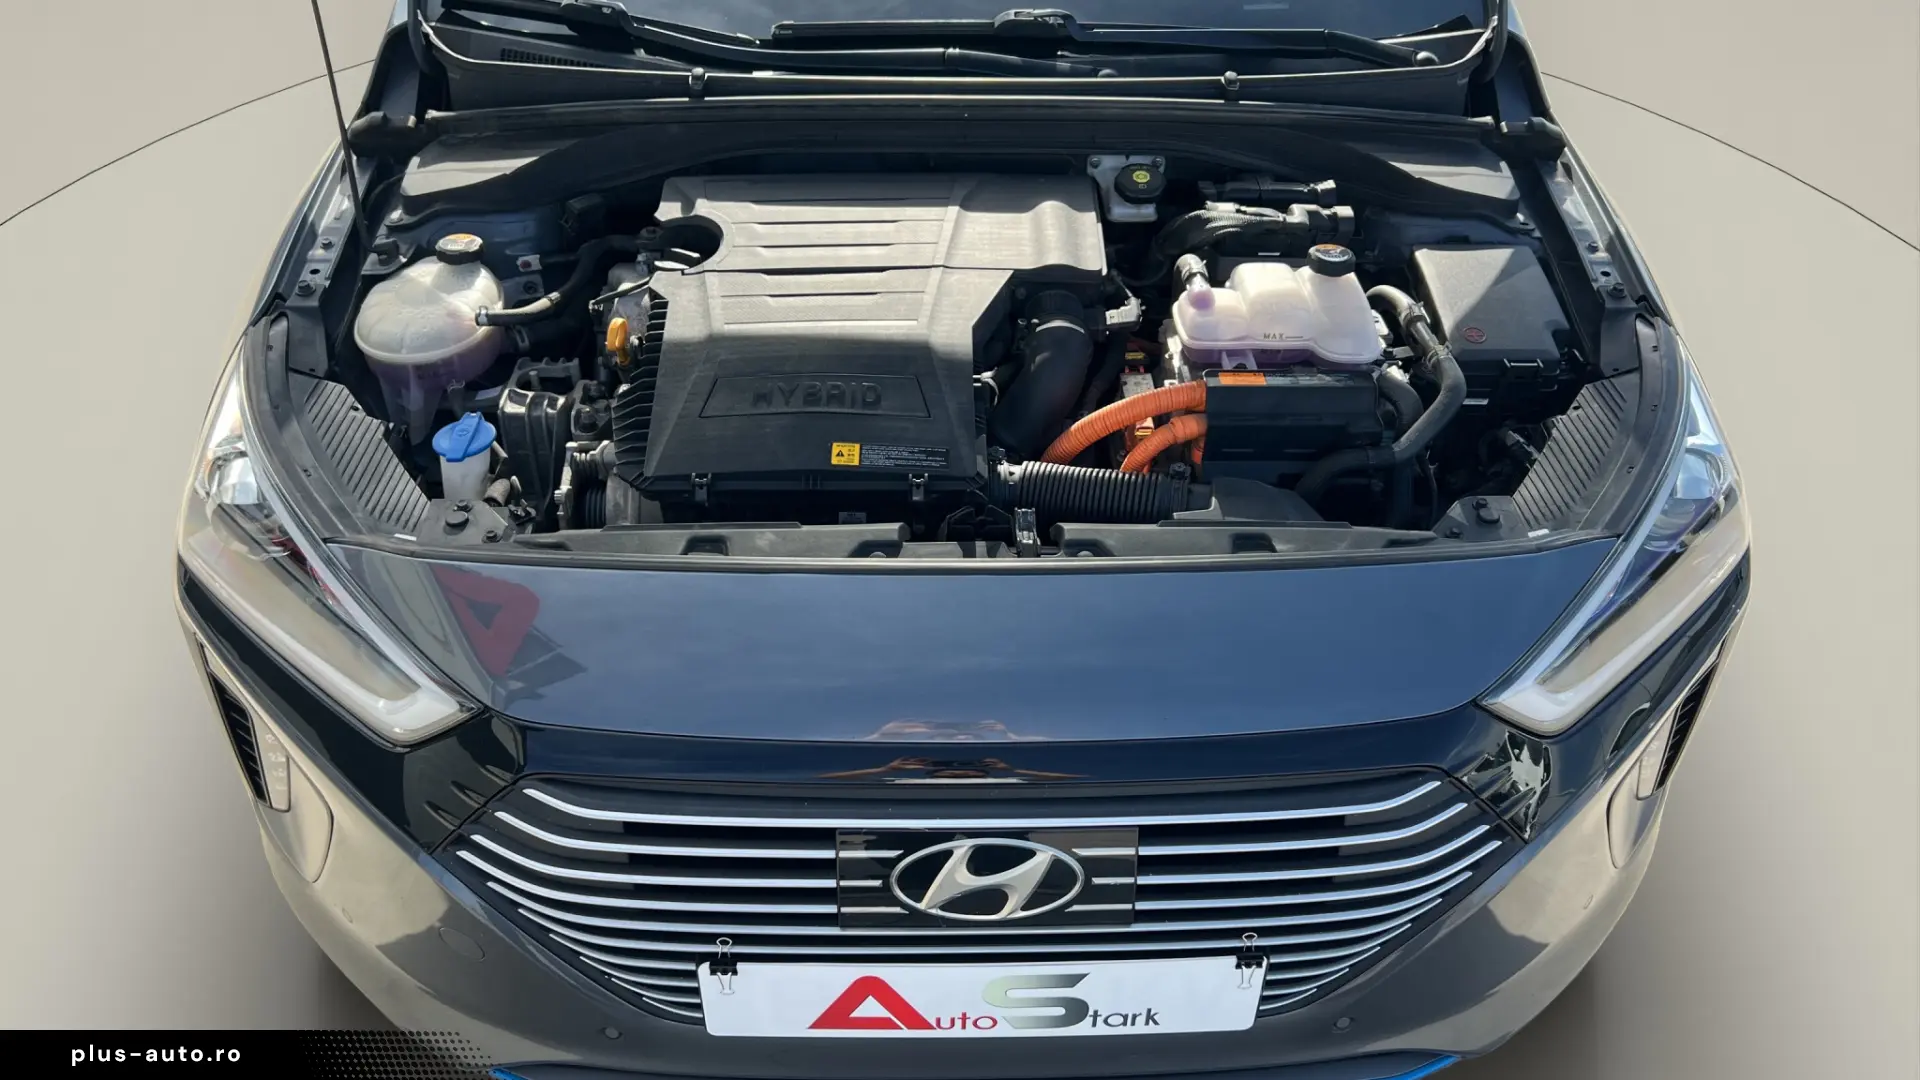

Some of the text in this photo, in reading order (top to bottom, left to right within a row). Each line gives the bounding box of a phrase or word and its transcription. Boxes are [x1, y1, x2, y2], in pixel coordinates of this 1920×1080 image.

[1263, 332, 1285, 340] MAX
[752, 381, 882, 410] HYBRID
[806, 972, 1161, 1030] Auto Stark
